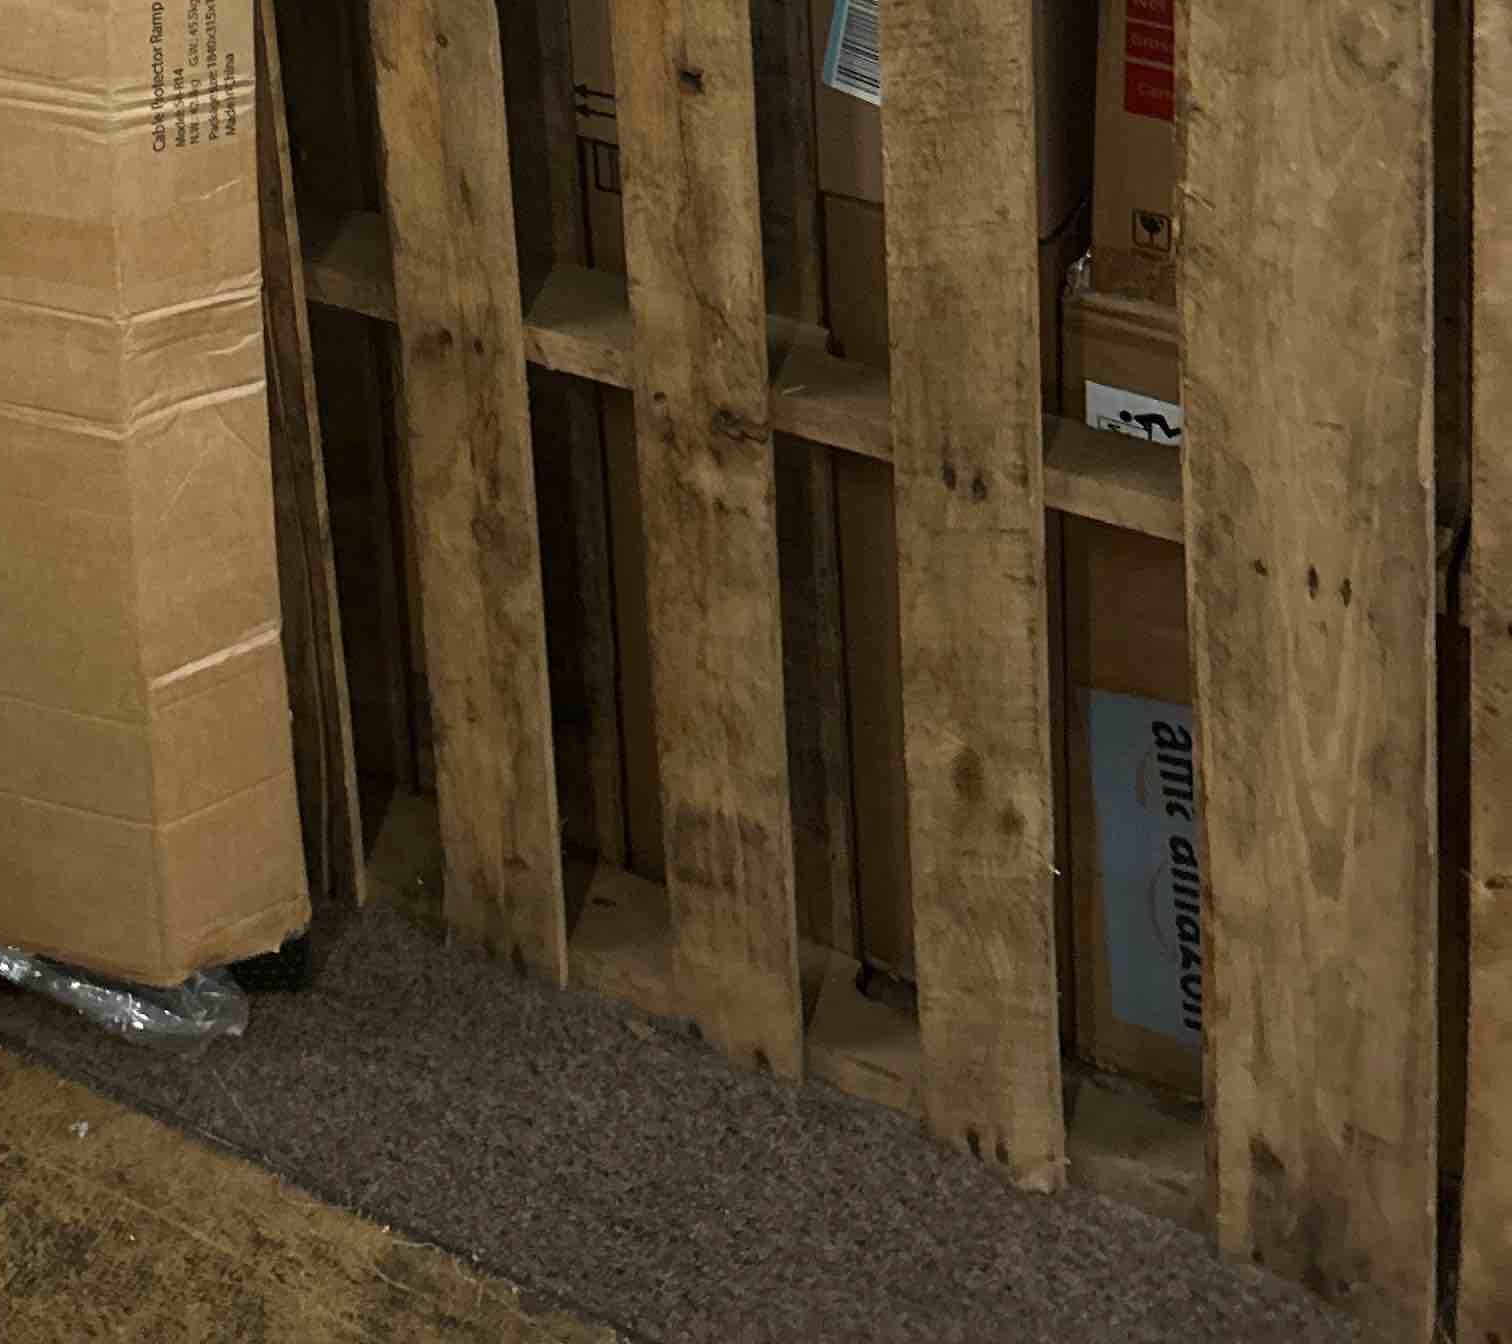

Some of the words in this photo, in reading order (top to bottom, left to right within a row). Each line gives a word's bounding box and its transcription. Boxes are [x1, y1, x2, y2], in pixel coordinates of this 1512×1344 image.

[149, 1, 165, 44] Ramp
[151, 46, 166, 111] Protector
[151, 113, 166, 152] Cable
